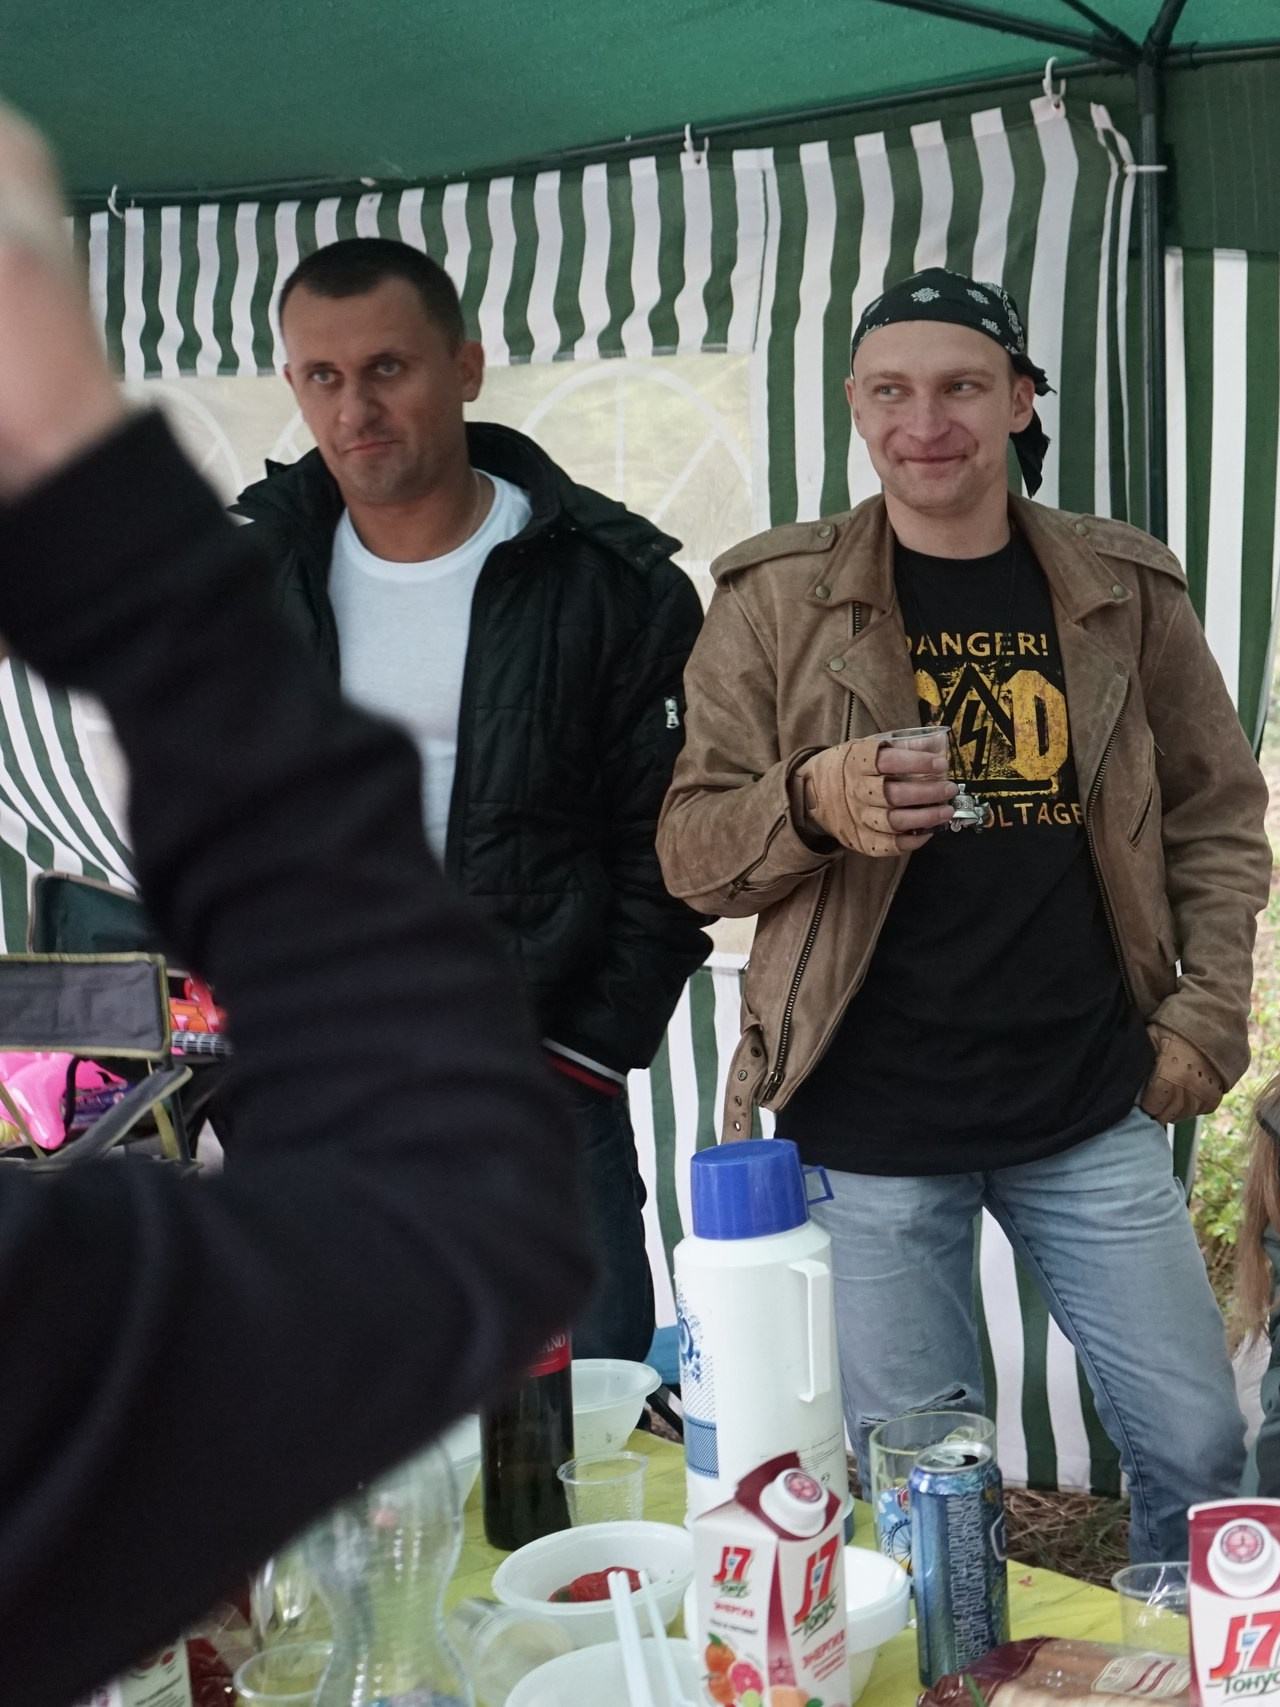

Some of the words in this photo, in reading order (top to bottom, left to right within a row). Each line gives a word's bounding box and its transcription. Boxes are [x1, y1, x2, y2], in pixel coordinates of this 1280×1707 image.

[981, 801, 1083, 829] OLTAGE
[713, 1546, 752, 1583] J7
[793, 1533, 839, 1628] J7
